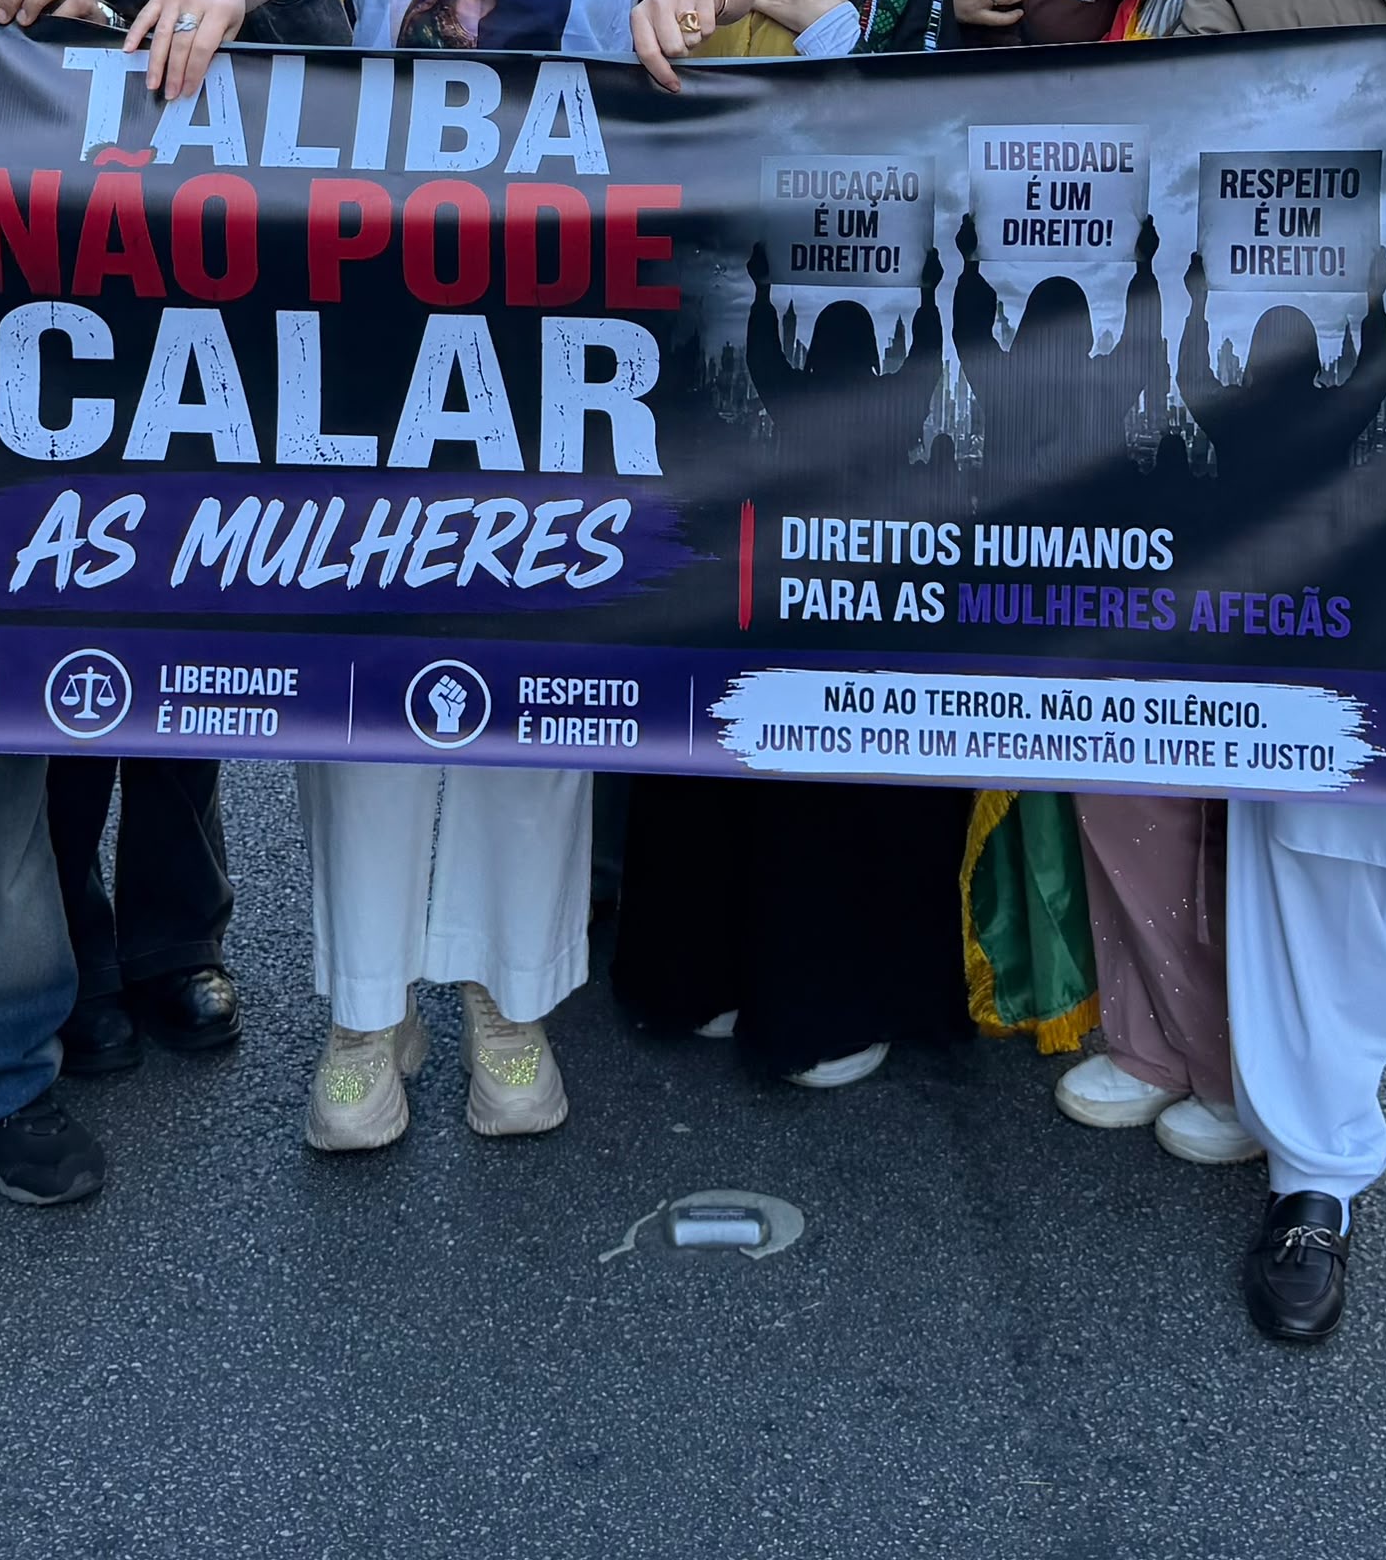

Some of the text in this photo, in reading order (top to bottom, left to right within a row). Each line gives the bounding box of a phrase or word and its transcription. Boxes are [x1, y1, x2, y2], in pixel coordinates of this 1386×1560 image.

[62, 47, 610, 176] TALIBA
[984, 141, 1134, 174] LIBERDADE
[775, 166, 920, 208] EDUCAÇÃO
[1026, 175, 1092, 212] É UM
[1219, 167, 1361, 200] RESPEITO
[813, 202, 879, 239] É UM
[1002, 218, 1113, 247] DIREITO!
[1254, 201, 1321, 238] É UM
[306, 178, 682, 310] PODE
[790, 244, 901, 274] DIREITO!
[1229, 244, 1346, 277] DIREITO!
[9, 490, 634, 595] AS MULHERES
[781, 516, 1174, 571] DIREITOS HUMANOS
[780, 576, 1352, 639] PARA AS MULHERES AFEGÃS
[159, 664, 299, 697] LIBERDADE
[519, 676, 640, 707] RESPEITO
[156, 699, 279, 737] É DIREITO
[824, 681, 1268, 729] NÃO AO TERROR. NÃO AO SILÊNCIO.
[517, 710, 639, 747] É DIREITO
[755, 723, 1335, 772] JUNTOS POR UM AFEGANISTÃO LIVRE E JUSTO!
